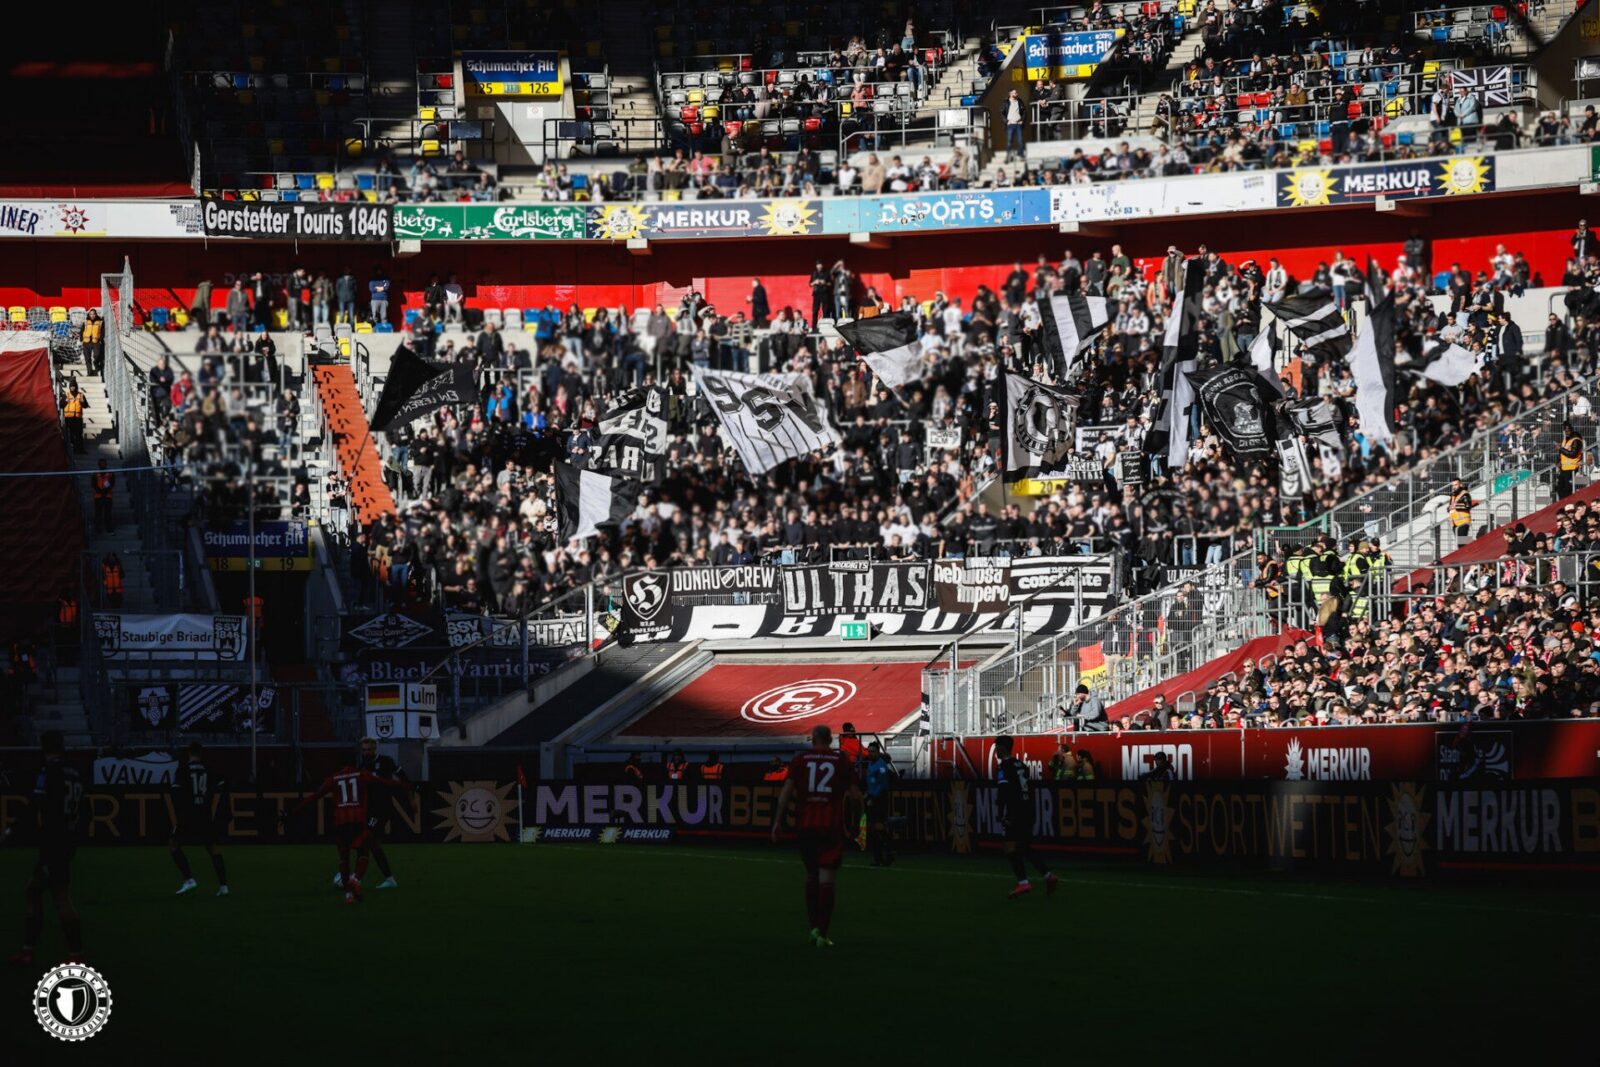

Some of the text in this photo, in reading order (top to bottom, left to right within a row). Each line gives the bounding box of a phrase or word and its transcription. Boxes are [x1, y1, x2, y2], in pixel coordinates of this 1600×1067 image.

[1030, 43, 1093, 57] Schumacher
[467, 60, 555, 74] Schumacher Alt
[474, 83, 493, 94] 125
[529, 83, 549, 94] 126
[1344, 169, 1431, 193] MERKUR
[205, 205, 289, 236] Gerstetter
[295, 206, 343, 236] Touris
[348, 206, 388, 236] 1846
[493, 206, 573, 237] Carlsberg
[657, 209, 750, 229] MERKUR
[1040, 481, 1052, 494] 20
[204, 531, 281, 547] Schumacher
[214, 559, 229, 569] 18
[281, 558, 294, 570] 19
[673, 568, 721, 592] DONAU
[736, 566, 775, 589] CREW
[934, 563, 1003, 585] nebulosa
[1018, 574, 1102, 590] constante
[785, 567, 926, 611] ULTRAS
[957, 584, 1009, 613] impero
[215, 622, 240, 631] SSV
[216, 630, 240, 639] 1846
[448, 619, 479, 635] SSV
[492, 621, 587, 646] BACHTAL
[122, 631, 173, 645] Staubige
[449, 632, 482, 647] 1846
[370, 658, 549, 679] Black Warriors
[411, 687, 435, 705] ulm
[786, 704, 816, 713] 95
[1307, 747, 1371, 781] MERKUR
[191, 771, 208, 796] 14
[806, 761, 835, 793] 12
[337, 777, 358, 803] 11
[535, 784, 724, 825] MERKUR
[1059, 787, 1137, 840] BETS
[1178, 791, 1382, 863] SPORTWETTEN
[1436, 788, 1562, 854] MERKUR
[544, 828, 591, 839] MERKUR
[624, 828, 671, 839] MERKUR
